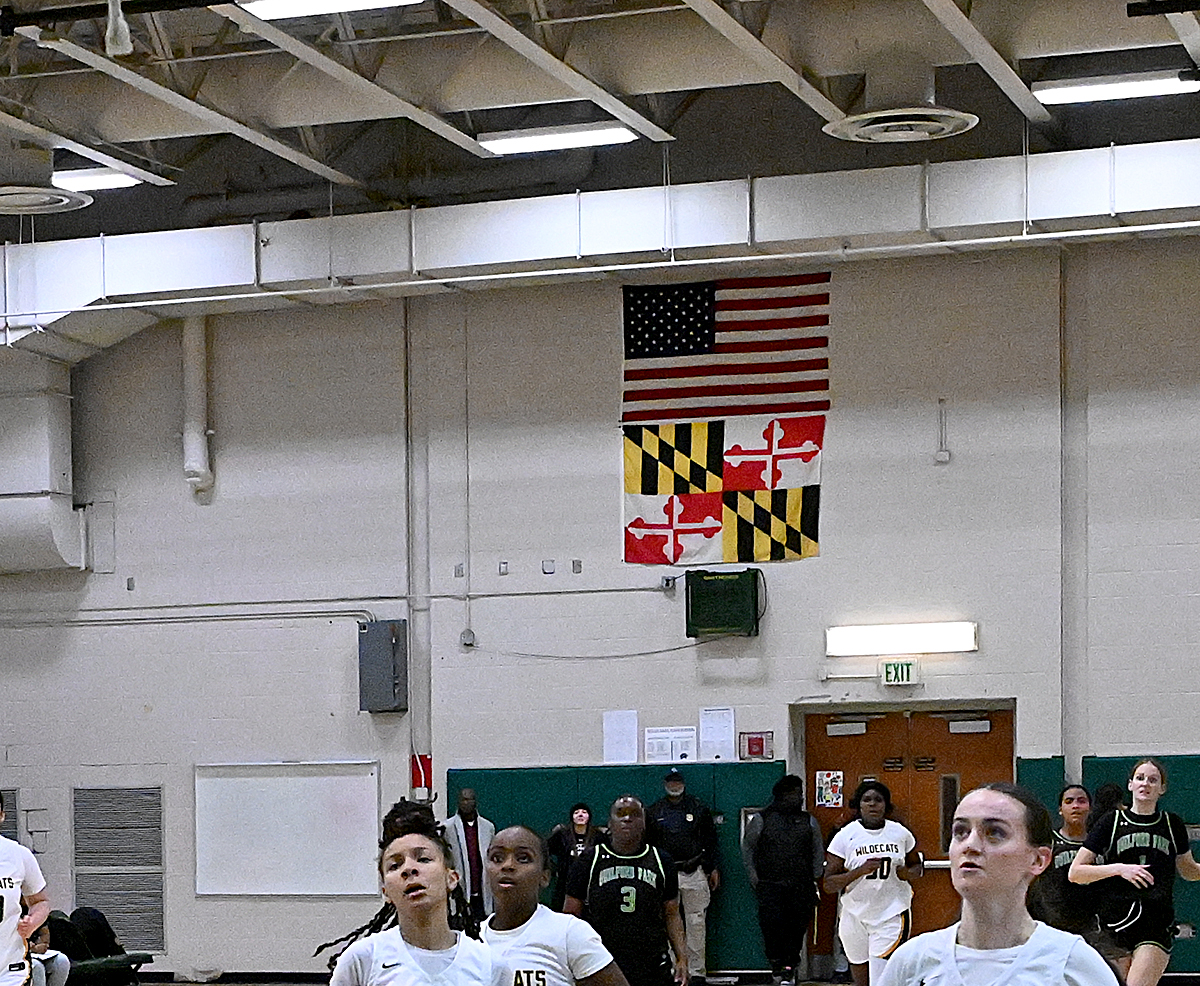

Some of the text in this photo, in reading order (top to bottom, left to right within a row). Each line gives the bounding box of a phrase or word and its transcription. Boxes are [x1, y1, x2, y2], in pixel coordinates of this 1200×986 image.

[885, 663, 912, 682] EXIT
[855, 843, 900, 857] WILDECATS
[620, 886, 637, 913] 3
